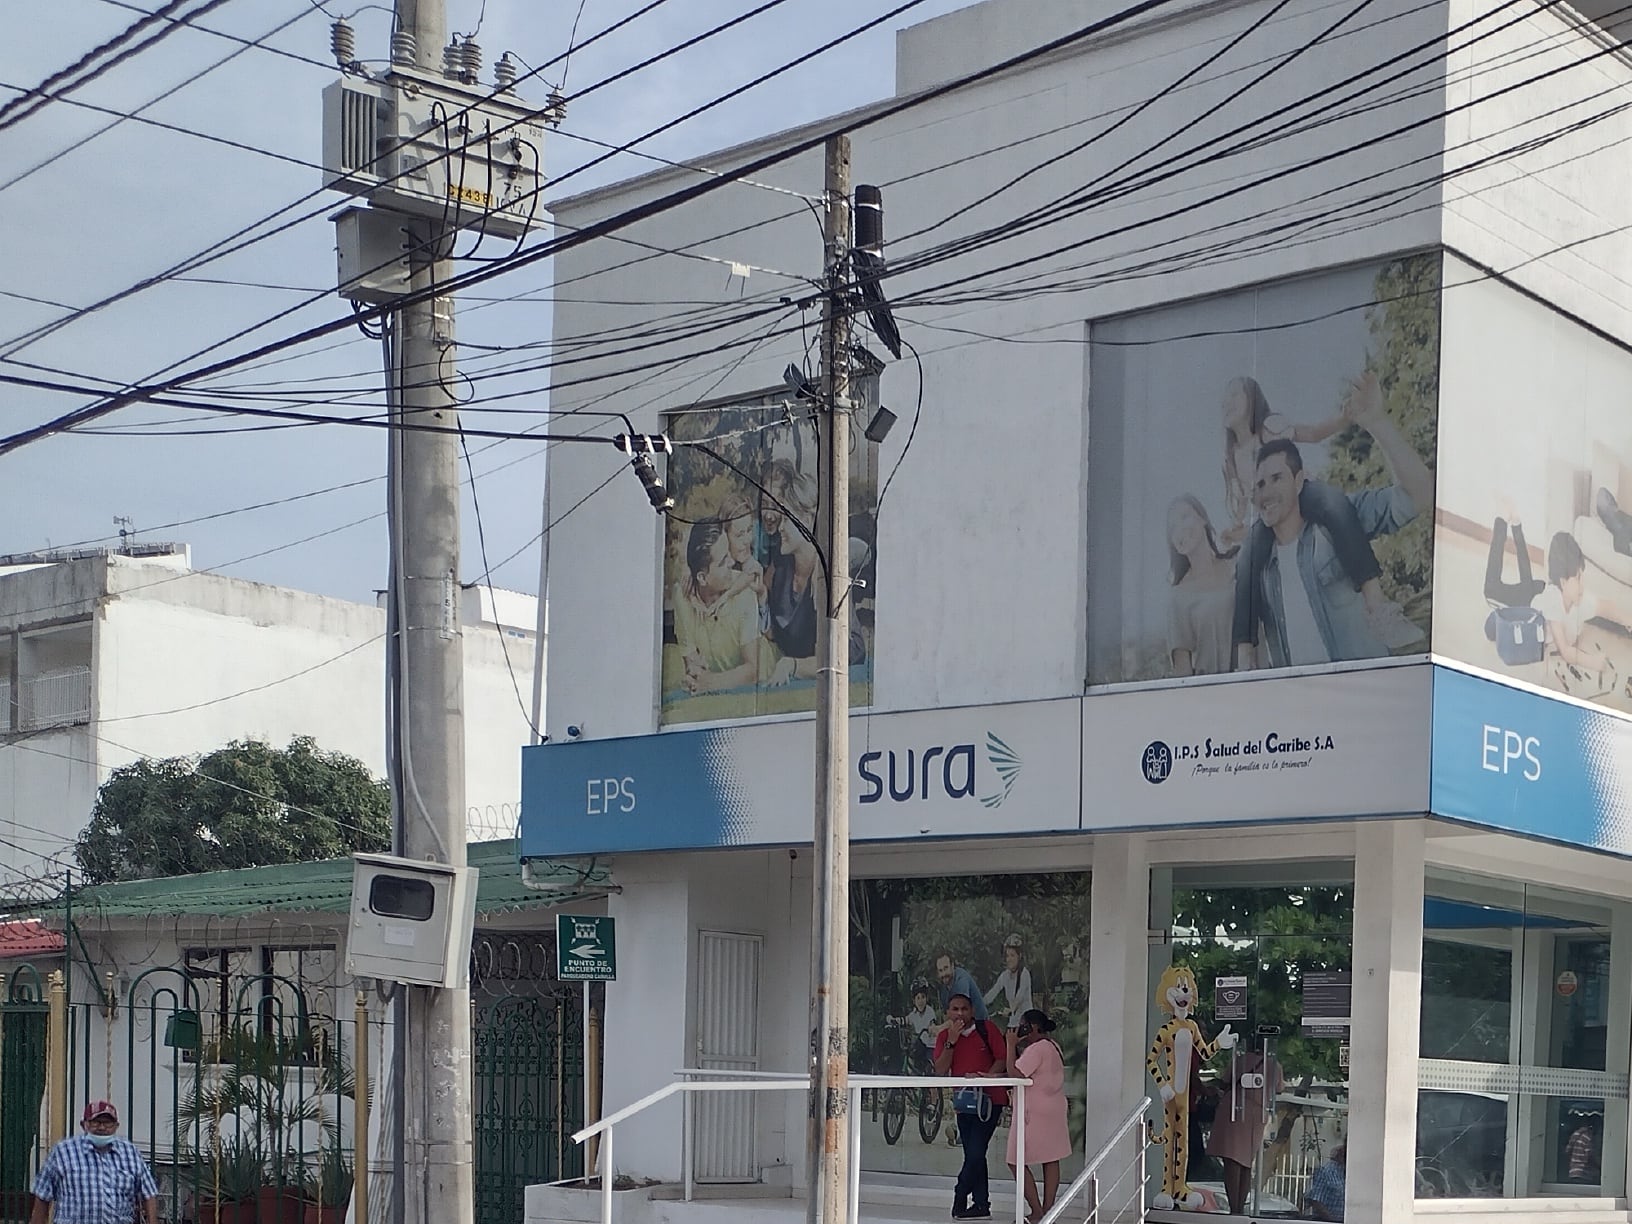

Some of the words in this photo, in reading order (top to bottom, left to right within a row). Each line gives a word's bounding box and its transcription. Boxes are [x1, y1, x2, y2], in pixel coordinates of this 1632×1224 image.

[1205, 738, 1240, 758] Salud
[1243, 740, 1262, 754] del
[1265, 732, 1311, 753] Caribe
[1314, 736, 1335, 750] S.A
[1482, 724, 1541, 781] EPS
[858, 744, 975, 803] sura
[1234, 760, 1260, 775] familia
[587, 776, 635, 814] EPS
